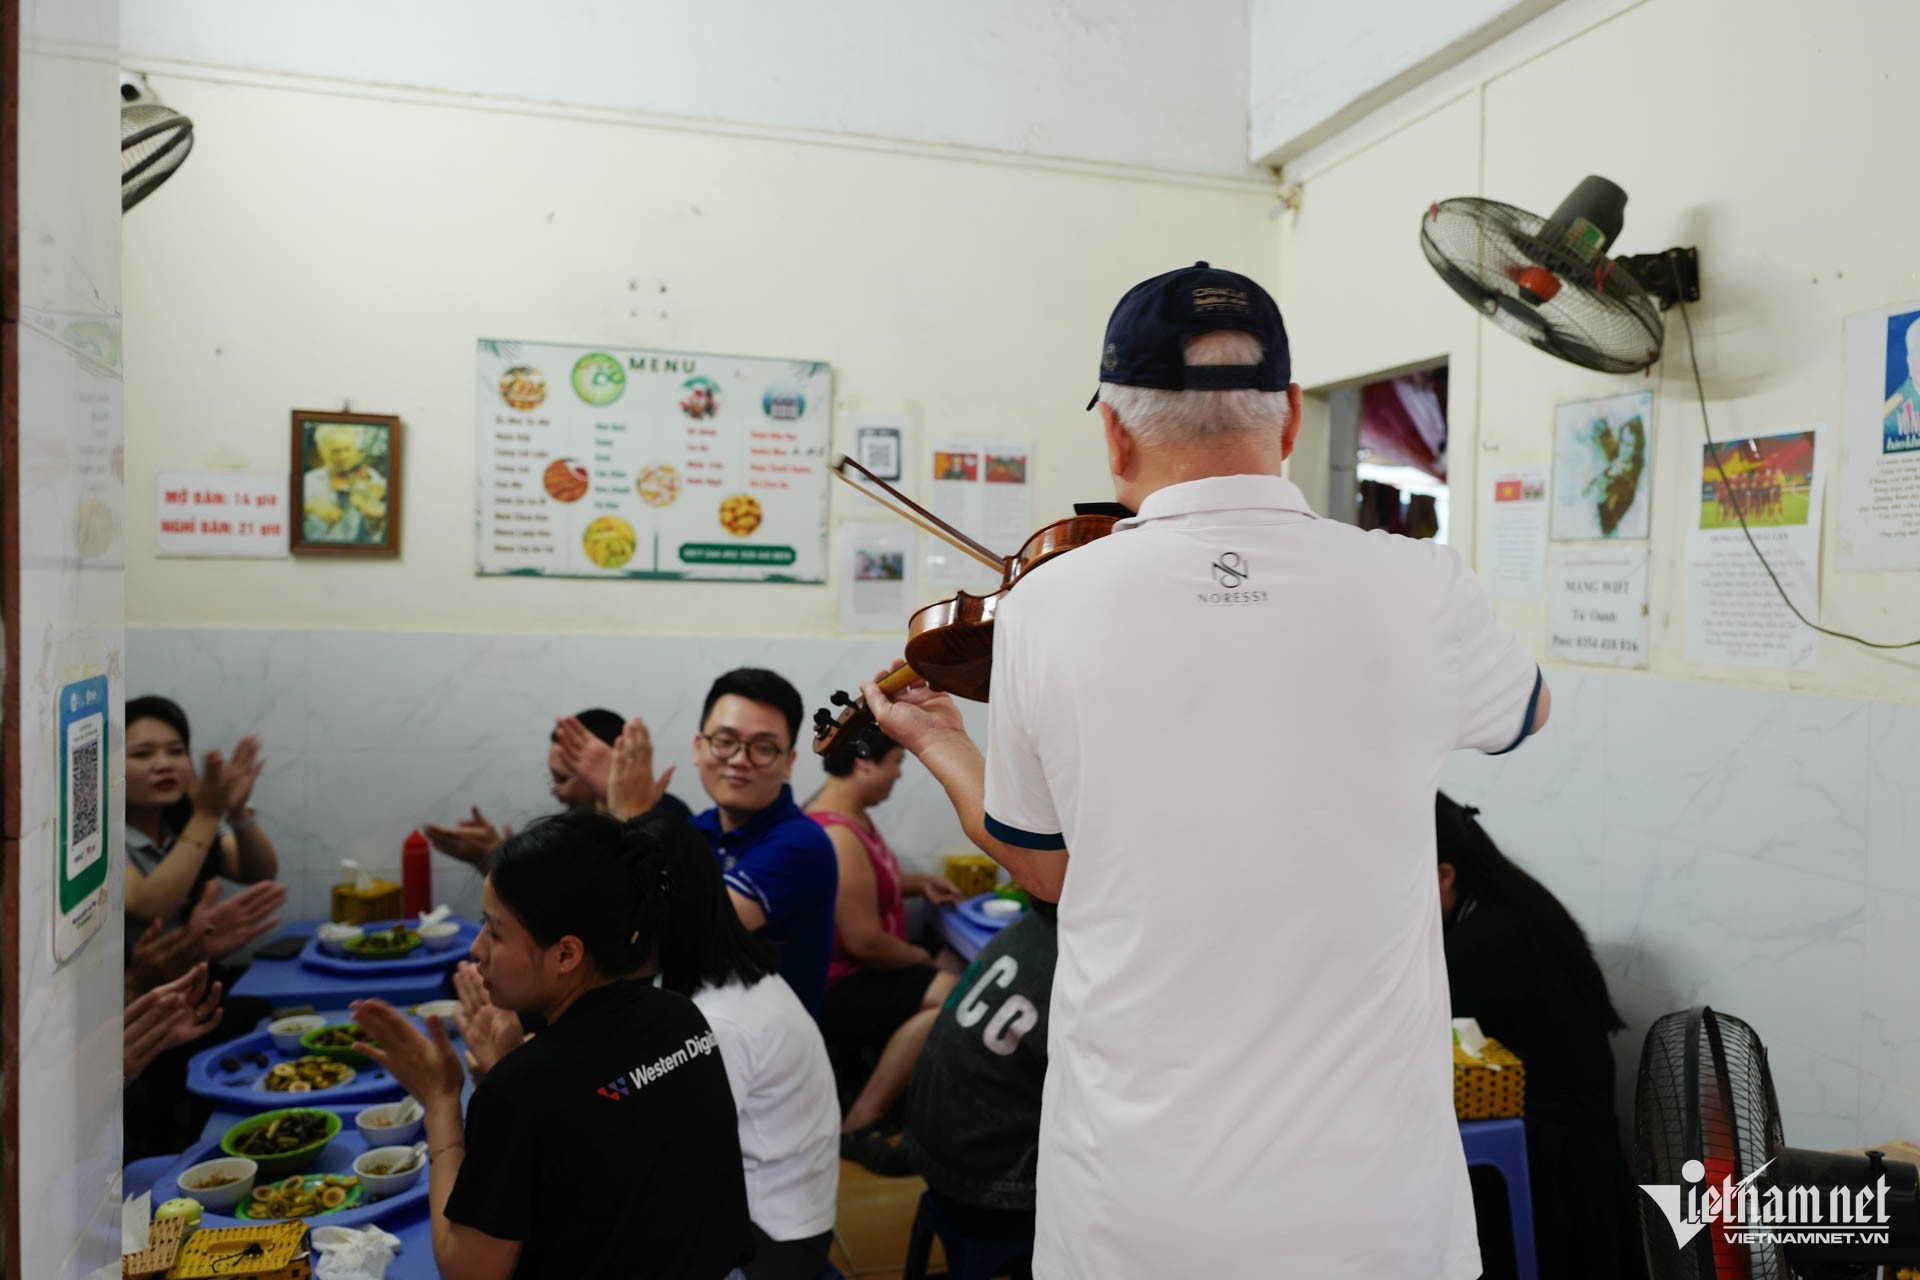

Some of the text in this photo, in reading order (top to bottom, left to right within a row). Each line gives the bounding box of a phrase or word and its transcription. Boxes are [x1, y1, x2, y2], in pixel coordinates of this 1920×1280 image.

[630, 357, 695, 374] MENU
[235, 492, 250, 505] 14
[239, 522, 254, 535] 21
[1197, 591, 1269, 604] NORESSY
[629, 1048, 689, 1090] Western
